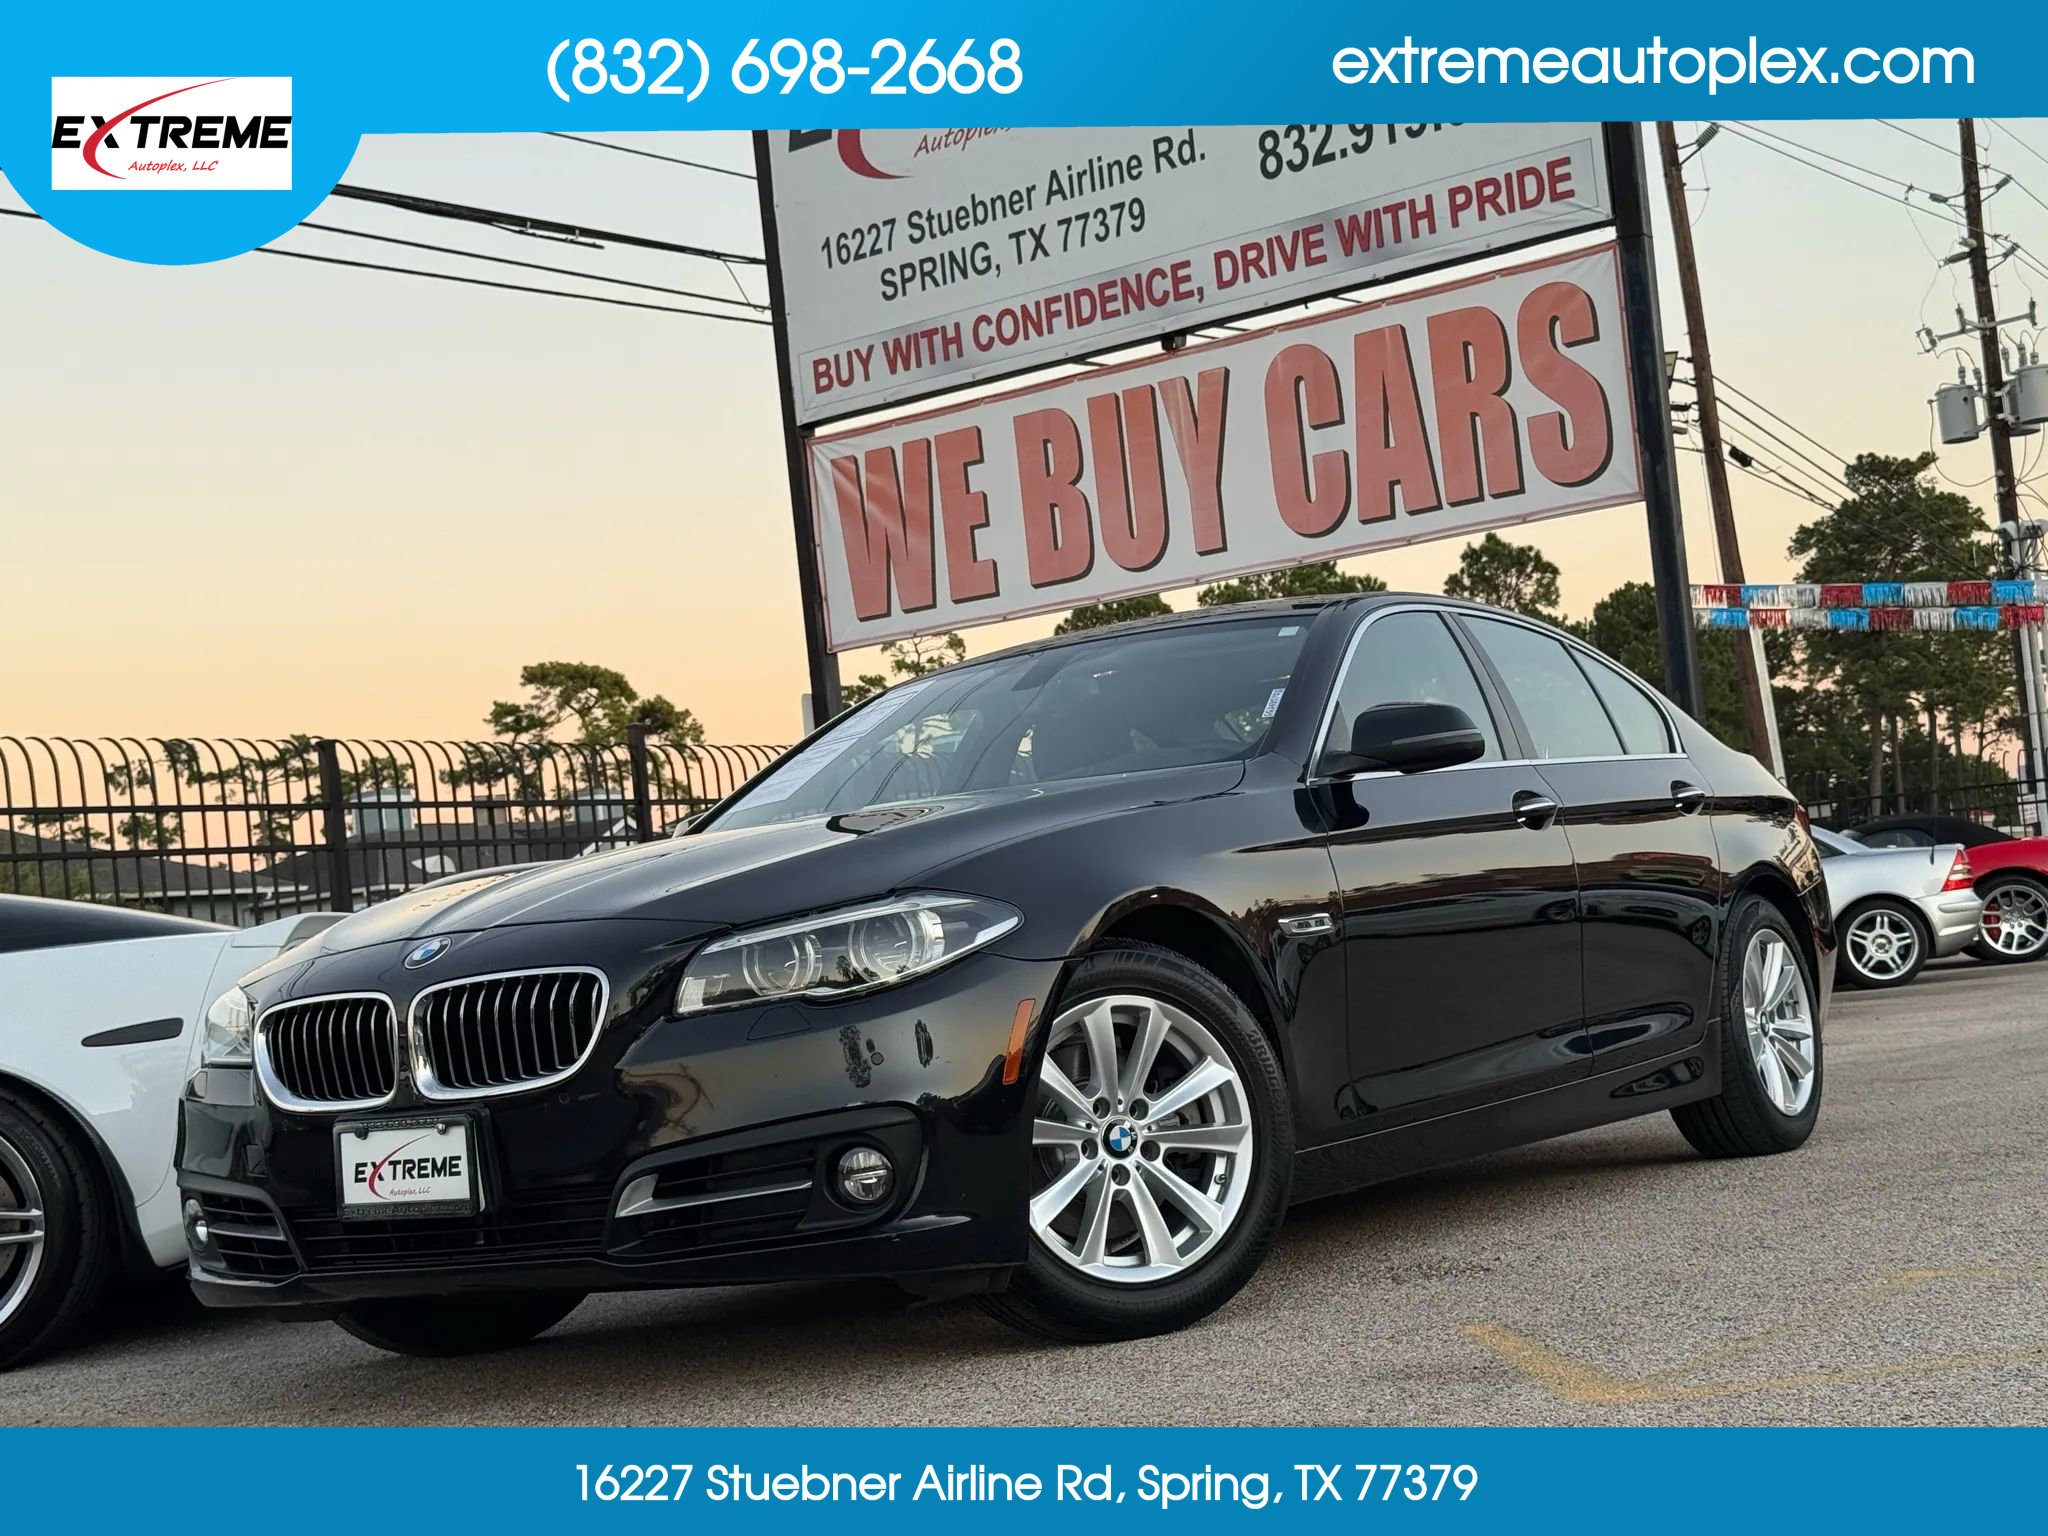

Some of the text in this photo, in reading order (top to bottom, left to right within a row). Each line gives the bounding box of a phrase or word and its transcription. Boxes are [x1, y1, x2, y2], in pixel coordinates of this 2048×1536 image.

[821, 128, 1207, 269] 16227 Stuebner Airline Rd.
[880, 197, 1146, 302] SPRING, TX 77379
[812, 156, 1576, 394] BUY WITH CONFIDENCE, DRIVE WITH PRIDE
[830, 281, 1615, 622] WE BUY CARS
[353, 1154, 463, 1184] EXTREME
[418, 1185, 432, 1195] LLC
